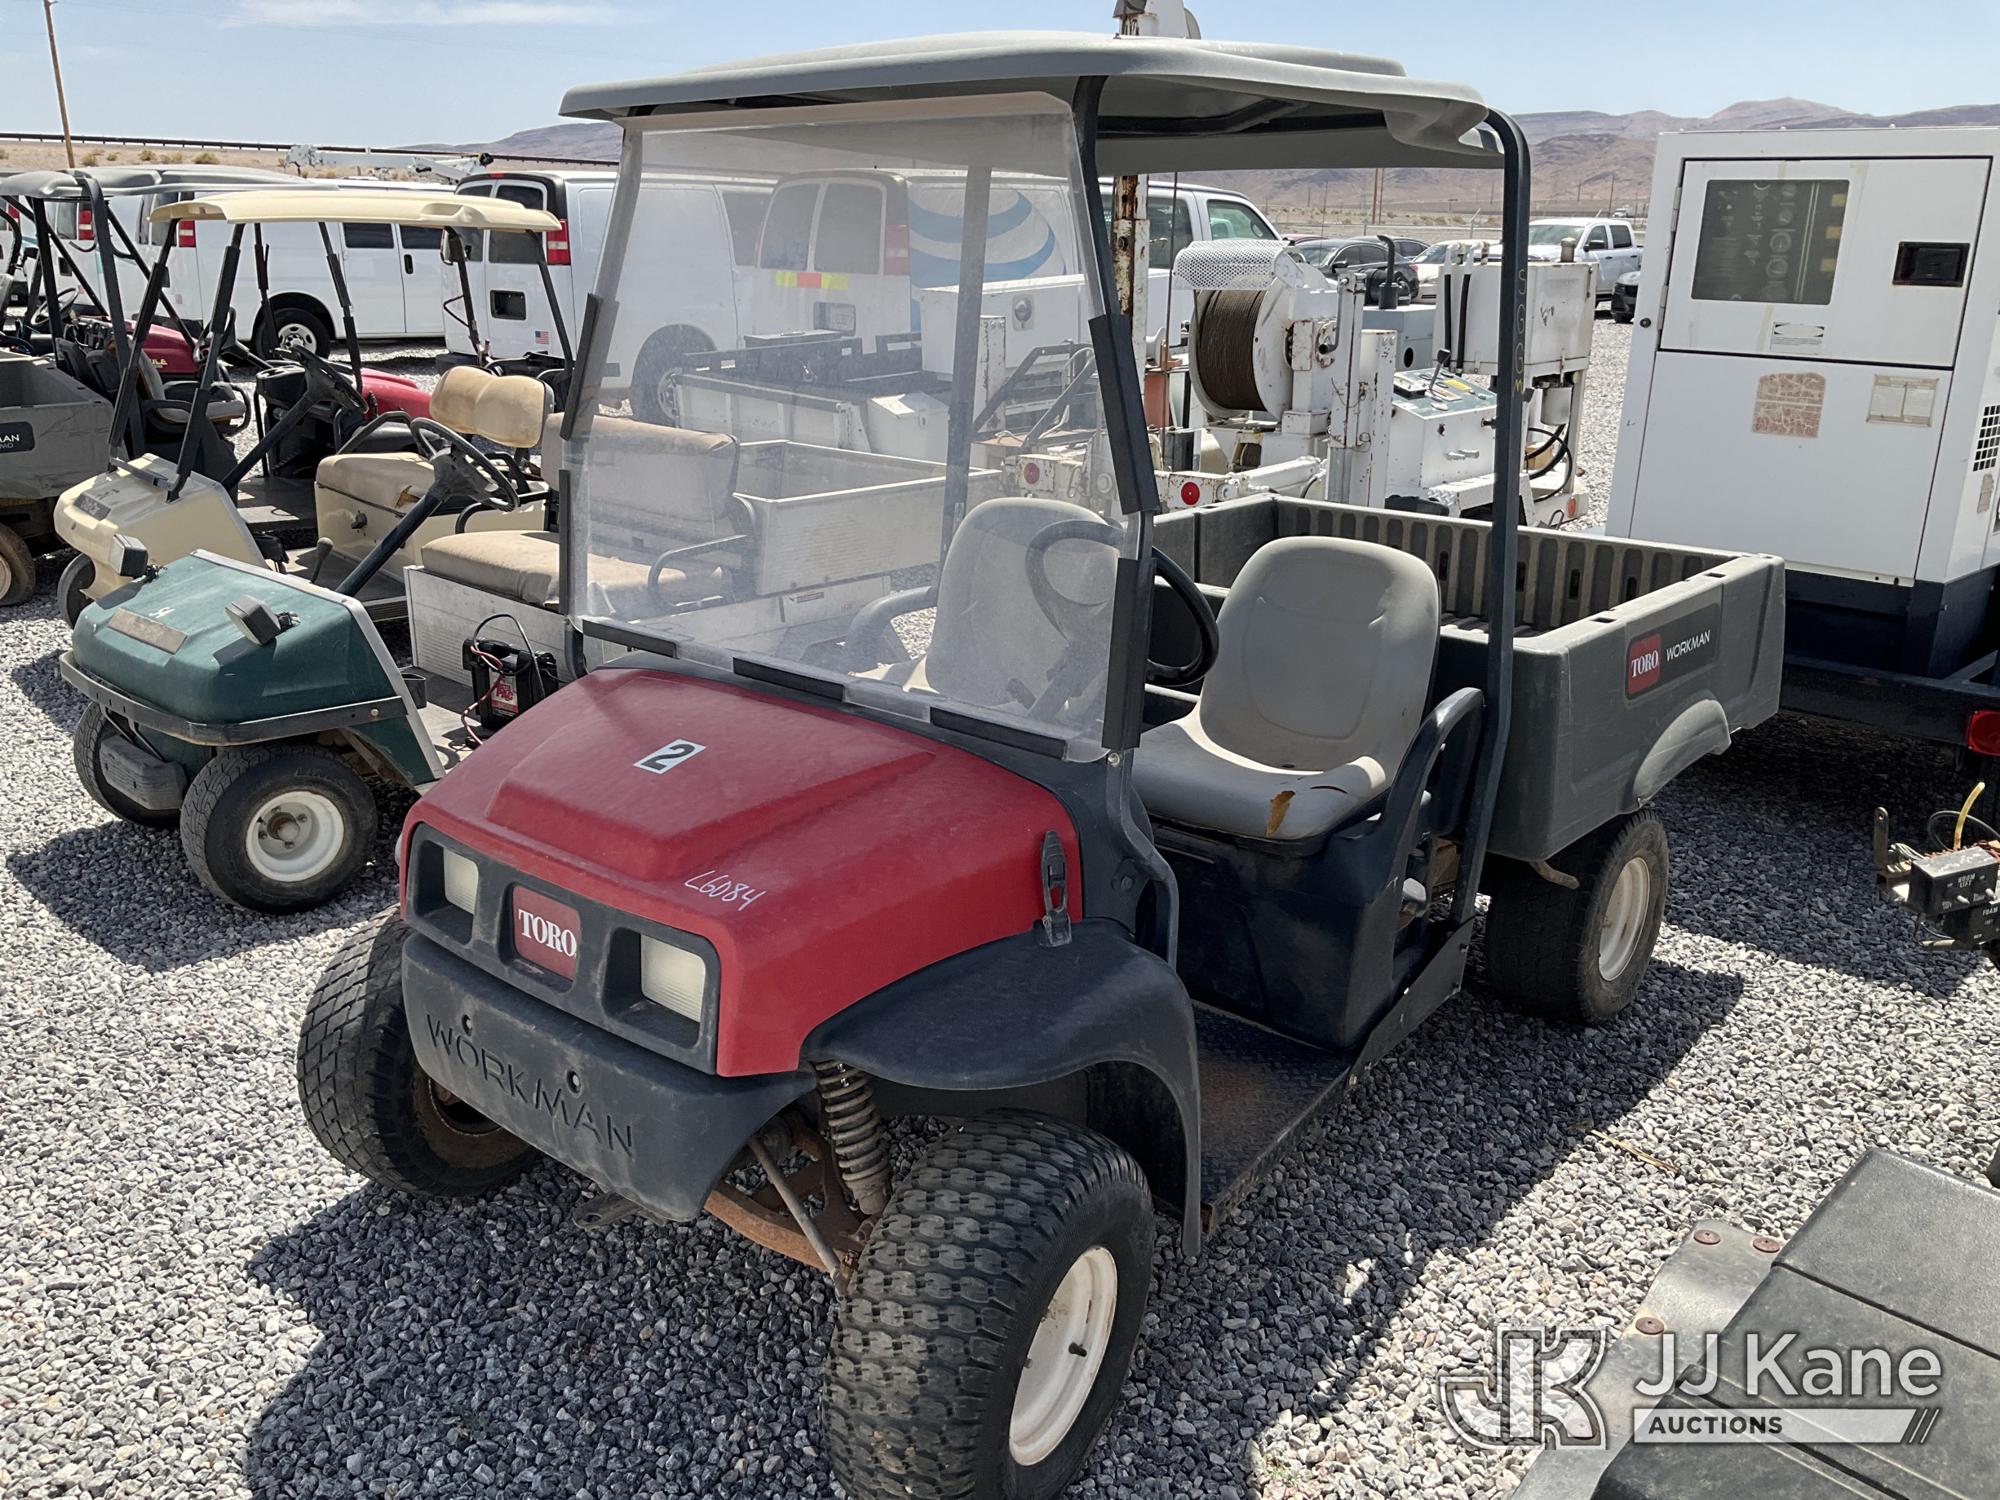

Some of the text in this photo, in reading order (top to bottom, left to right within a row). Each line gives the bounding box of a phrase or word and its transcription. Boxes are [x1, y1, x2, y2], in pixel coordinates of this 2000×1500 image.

[1631, 628, 1711, 678] TORO WORKMAN
[640, 743, 696, 771] 2
[684, 869, 767, 912] L6084
[518, 908, 578, 959] TORO
[426, 1013, 634, 1158] WORKMAN
